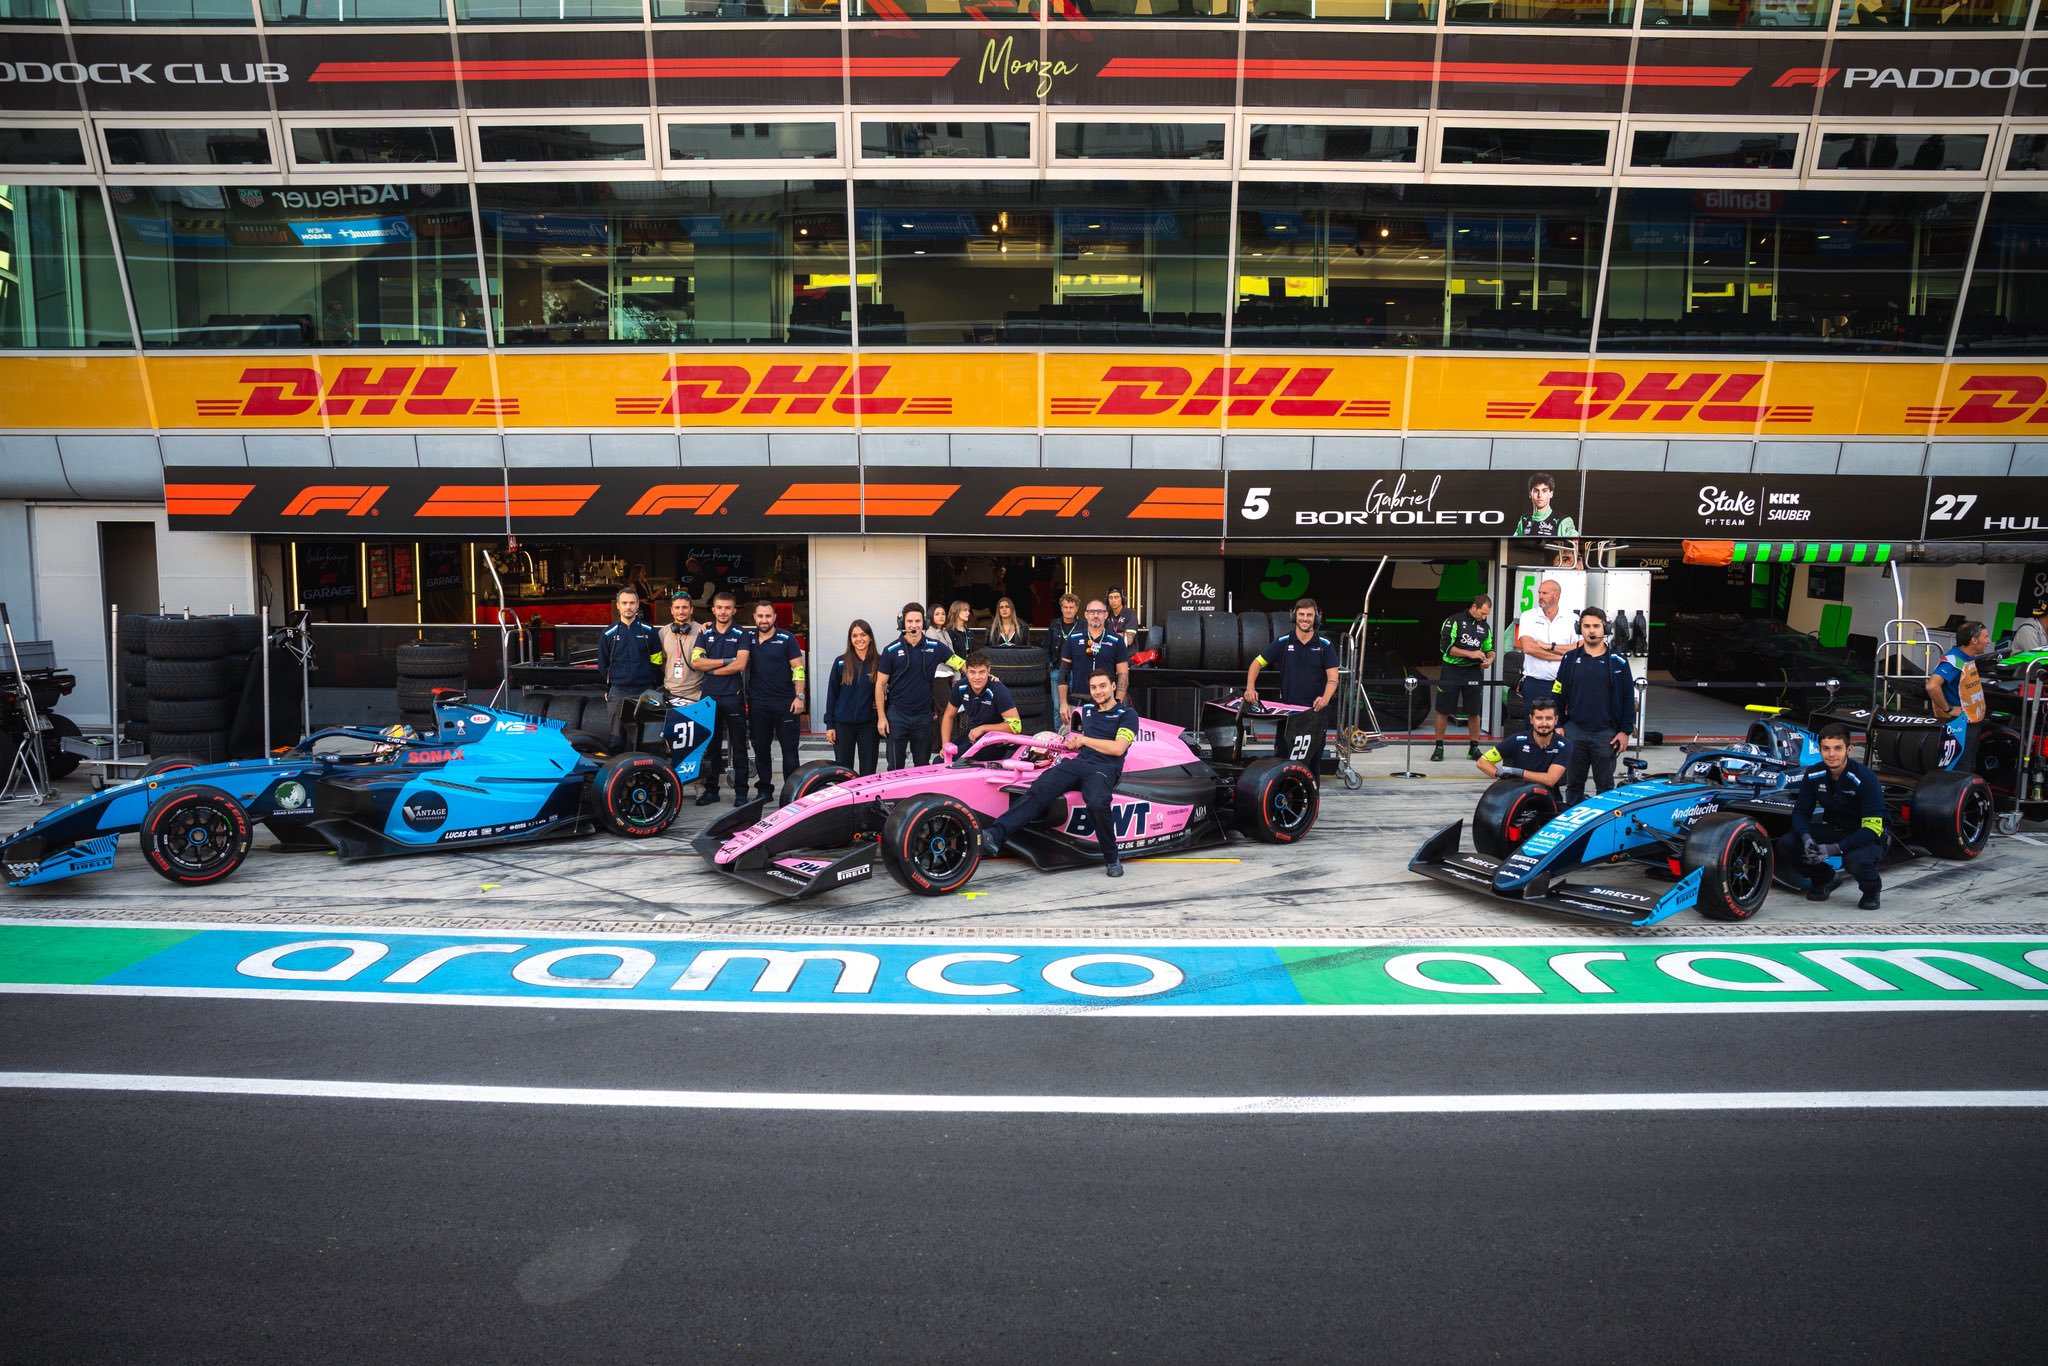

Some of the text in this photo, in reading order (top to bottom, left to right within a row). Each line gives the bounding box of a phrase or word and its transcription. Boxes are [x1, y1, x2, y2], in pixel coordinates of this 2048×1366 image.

[164, 63, 289, 85] CLUB
[979, 36, 1078, 98] Monza
[239, 367, 475, 415] DHL
[661, 366, 907, 414] DHL
[1096, 366, 1344, 416] DHL
[1529, 371, 1771, 421] DHL
[280, 485, 390, 516] F1
[626, 484, 741, 516] F1
[985, 486, 1104, 517] F1
[1241, 487, 1271, 520] 5
[1365, 473, 1442, 514] Gabriel
[1698, 485, 1755, 517] Stake
[1769, 493, 1799, 504] KICK
[1767, 509, 1811, 521] SAUBER
[1930, 494, 1978, 520] 27
[1295, 510, 1504, 525] BORTOLETO
[1720, 518, 1745, 526] TEAM
[427, 575, 461, 587] GARAGE
[1260, 557, 1310, 601] 5
[303, 586, 356, 600] GARAGE
[1181, 581, 1216, 599] Stake
[1519, 575, 1536, 614] 5
[672, 721, 695, 750] 31
[1130, 729, 1156, 742] llar
[407, 749, 465, 764] SONAX
[1289, 734, 1311, 761] 29
[1938, 740, 1957, 767] 30
[1289, 765, 1313, 780] ZERO
[224, 802, 247, 836] ZERO
[403, 805, 447, 822] VANTAGE
[953, 803, 980, 829] ZERO
[1194, 805, 1207, 817] ADA
[1556, 806, 1606, 824] 30
[1671, 803, 1719, 820] Andalucita
[445, 829, 479, 839] LUCAS OIL
[1539, 830, 1566, 841] win
[69, 857, 112, 871] PIRELLI
[792, 861, 824, 875] BW
[837, 863, 870, 881] PIRELLI
[1462, 856, 1499, 870] DIRECT
[1590, 887, 1651, 902] DIRECTV
[1676, 890, 1697, 906] PIRELLI
[234, 938, 1185, 998] aramco
[1383, 947, 2048, 994] aram
